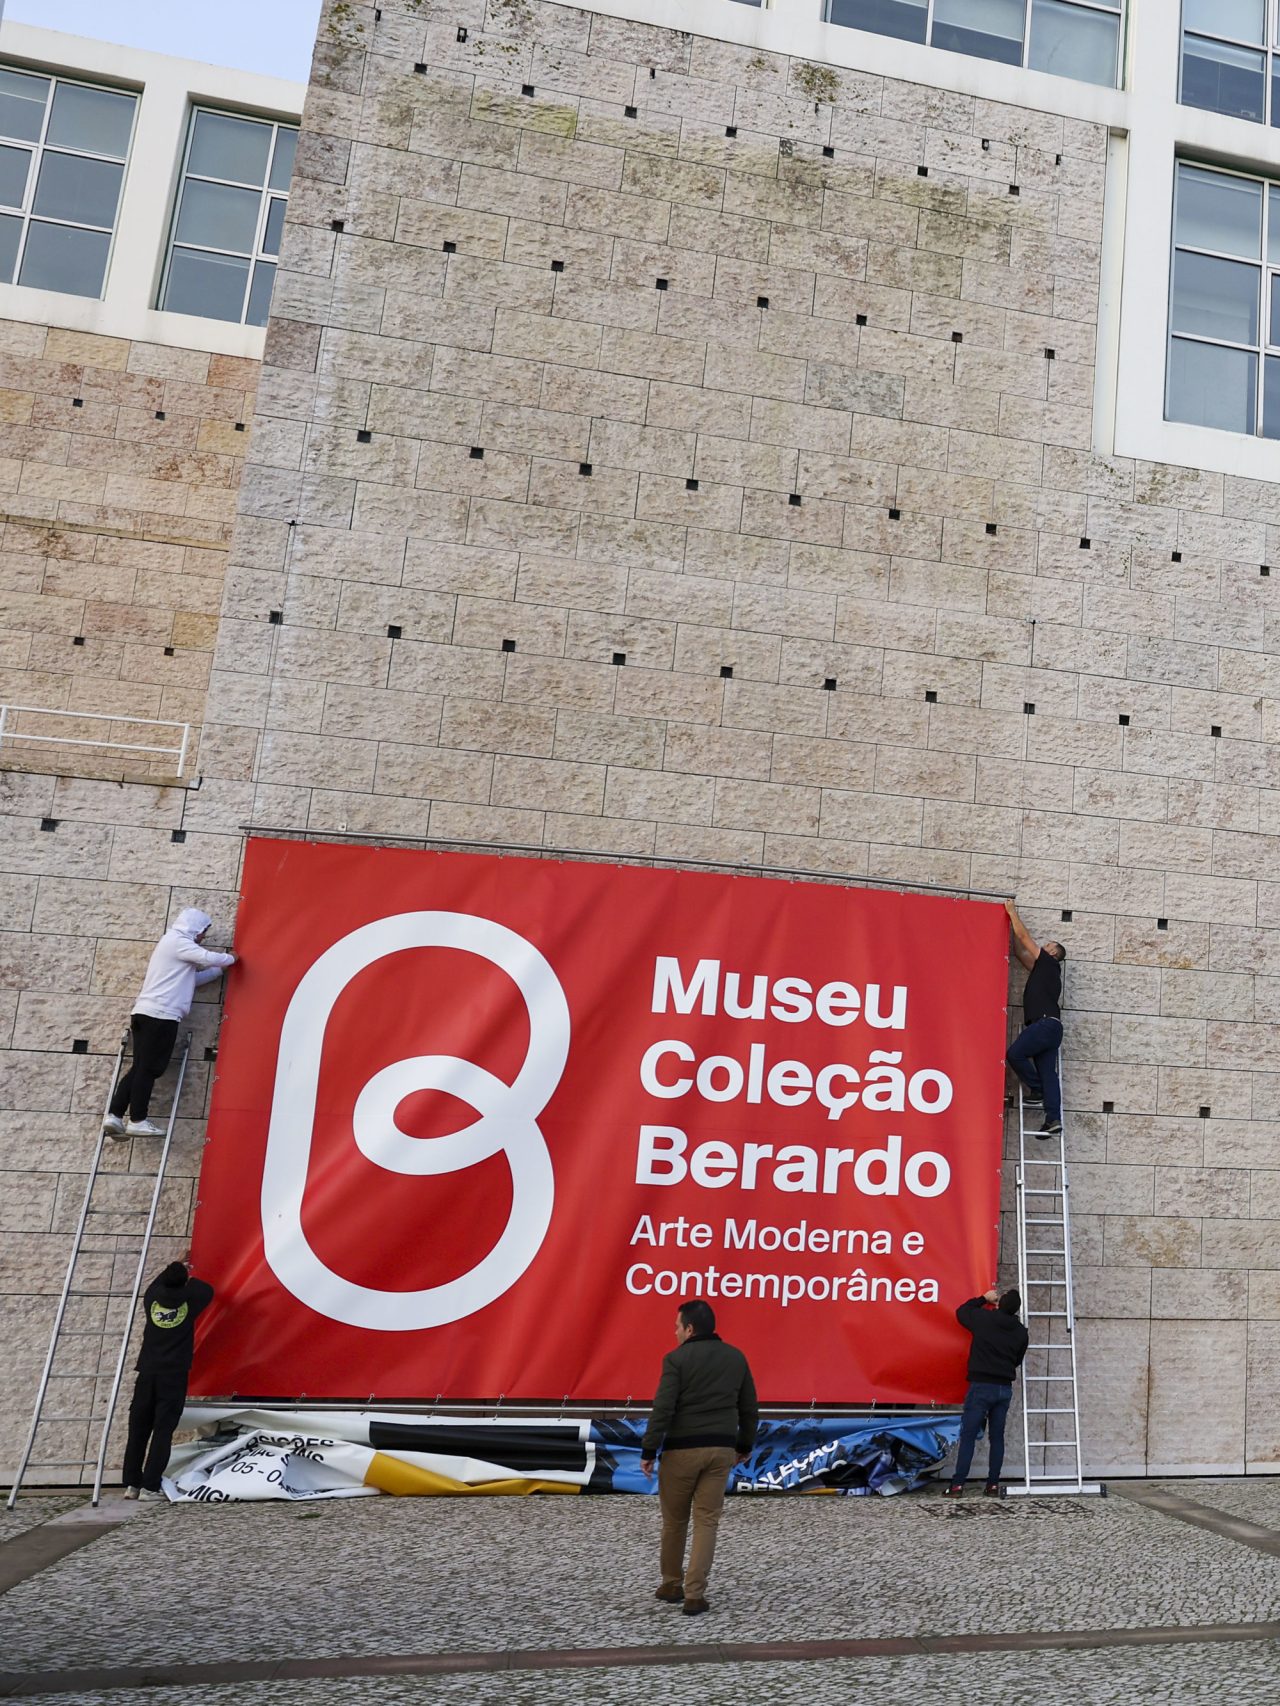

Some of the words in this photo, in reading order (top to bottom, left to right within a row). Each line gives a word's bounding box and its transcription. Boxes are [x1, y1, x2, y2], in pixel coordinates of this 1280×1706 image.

[652, 956, 907, 1029] Museu
[640, 1040, 953, 1120] Coleção
[636, 1125, 950, 1197] Berardo
[630, 1215, 713, 1248] Arte
[723, 1218, 892, 1255] Moderna
[902, 1231, 925, 1256] e
[625, 1262, 939, 1307] Contemporânea
